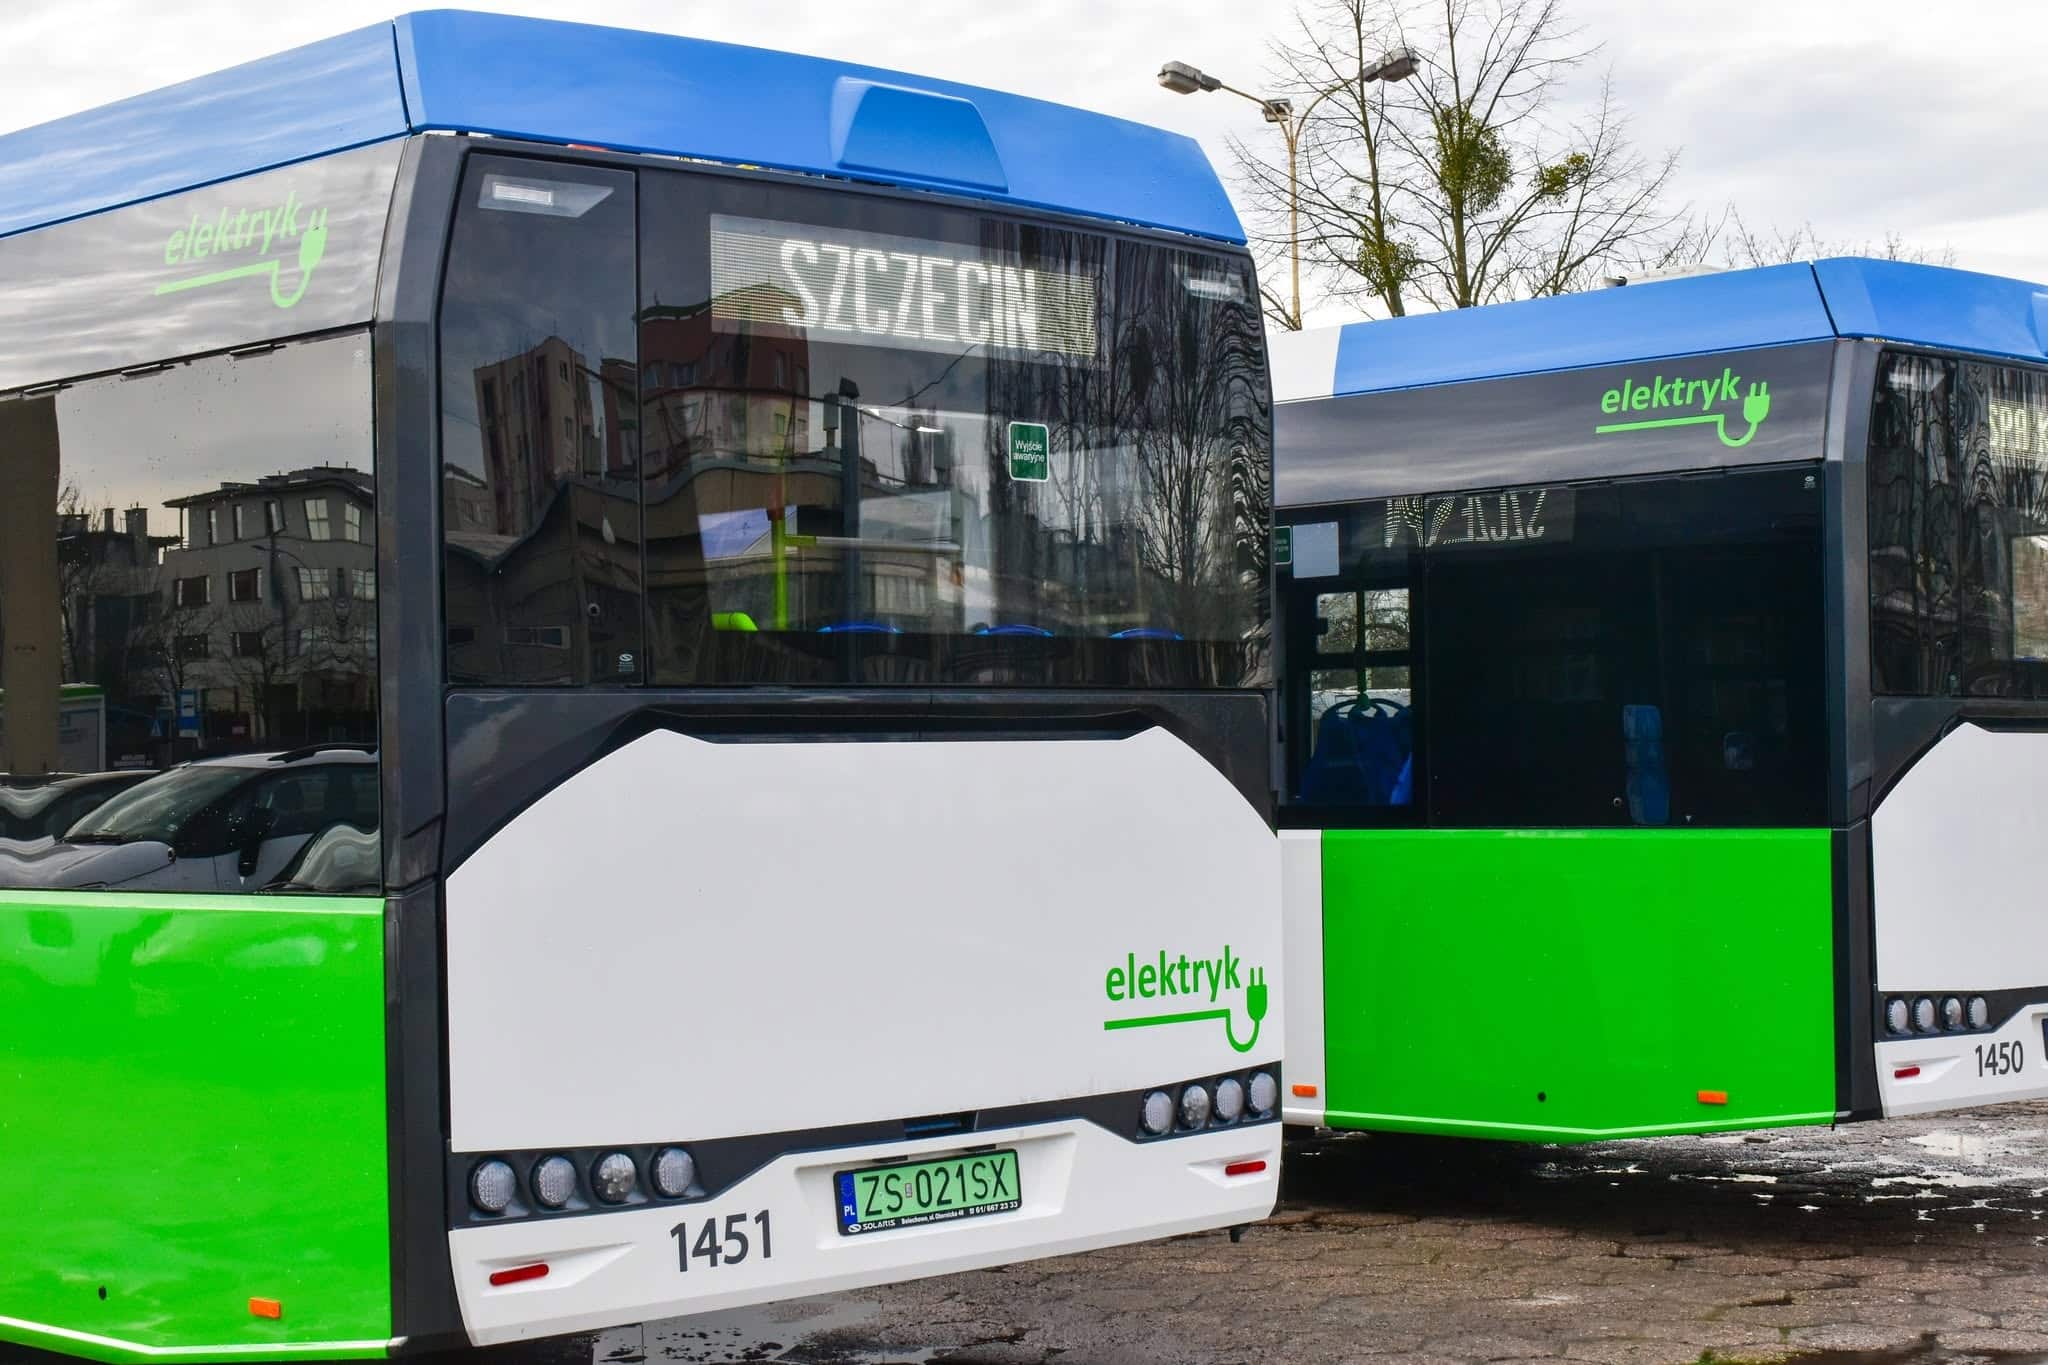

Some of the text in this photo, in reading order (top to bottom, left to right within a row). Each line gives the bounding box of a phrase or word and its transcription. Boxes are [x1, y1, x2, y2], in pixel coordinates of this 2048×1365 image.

[165, 191, 302, 265] elektryk
[780, 239, 1039, 350] SZCZECIN
[1601, 368, 1740, 414] elektryk
[1106, 945, 1241, 1003] elektryk
[1975, 1040, 2024, 1077] 1450
[844, 1205, 856, 1217] PL
[862, 1158, 1009, 1217] ZS 021SX
[670, 1209, 772, 1272] 1451
[862, 1219, 896, 1231] SOLARIS
